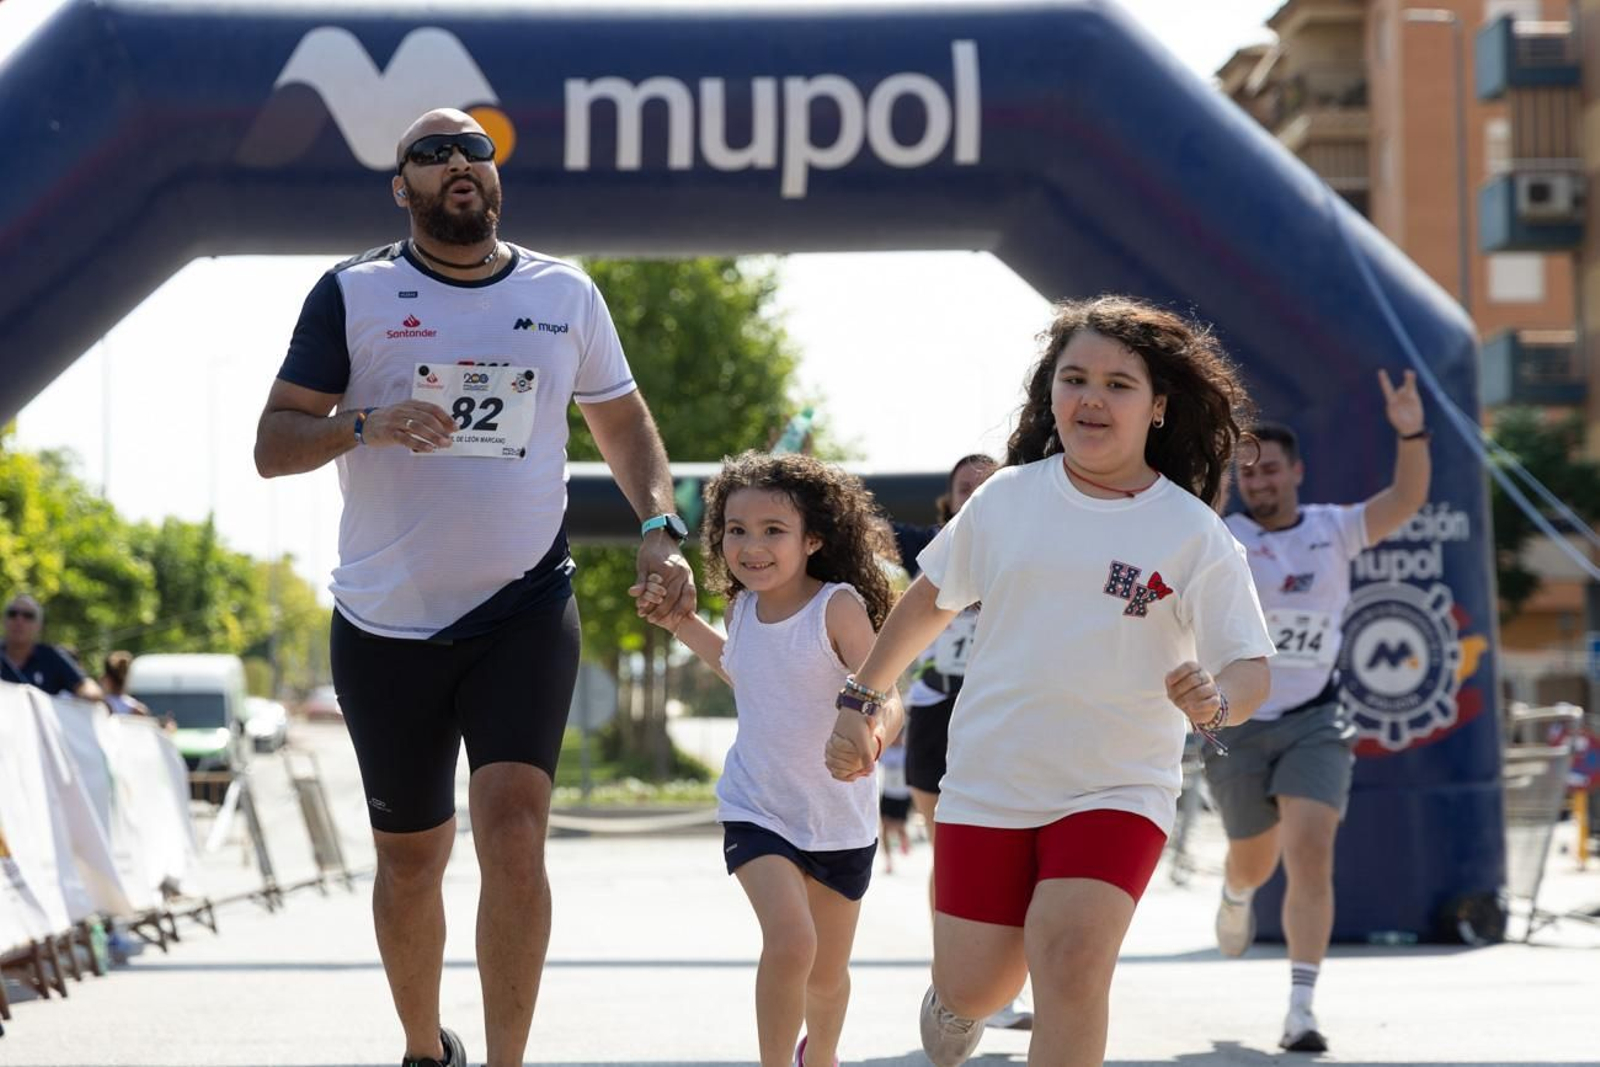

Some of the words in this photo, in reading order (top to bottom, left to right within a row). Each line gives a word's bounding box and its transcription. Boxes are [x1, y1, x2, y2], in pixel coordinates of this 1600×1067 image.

[564, 39, 981, 198] mupol
[386, 329, 437, 339] Santander
[538, 322, 569, 335] mupol
[452, 396, 504, 431] 82
[1103, 560, 1160, 618] HK
[1276, 628, 1323, 652] 214
